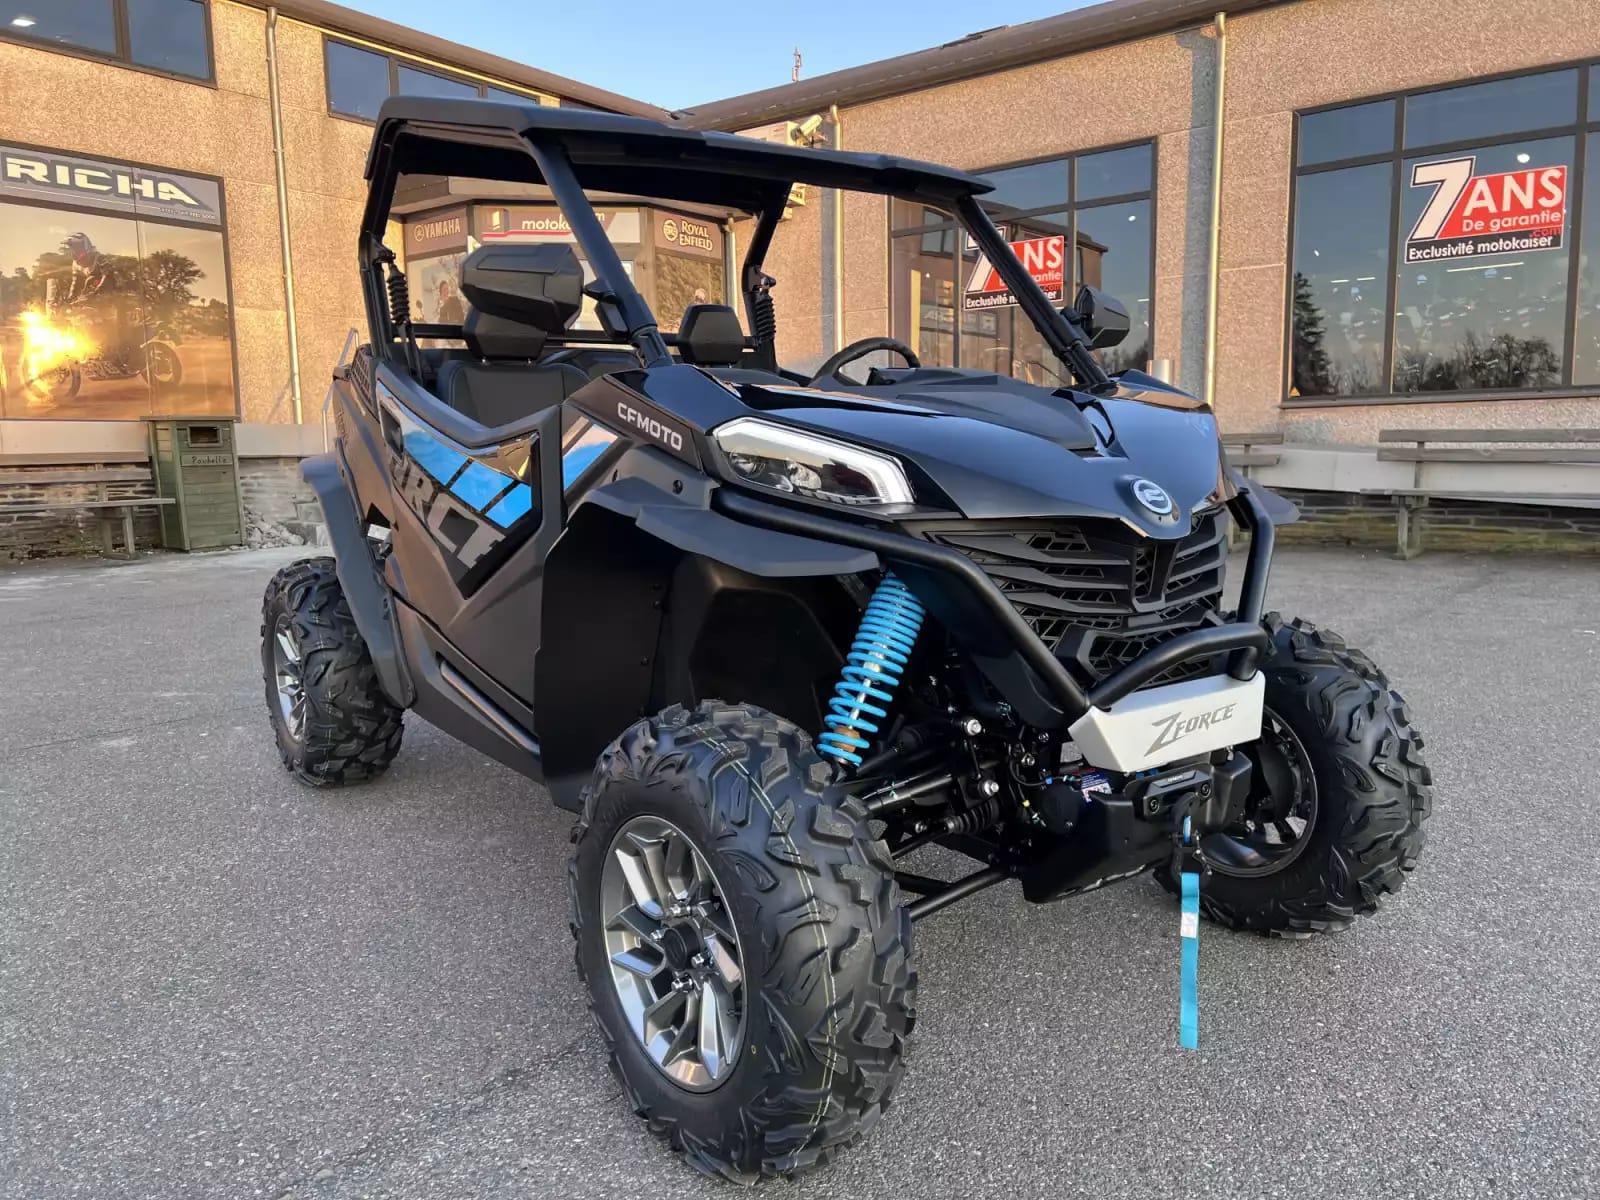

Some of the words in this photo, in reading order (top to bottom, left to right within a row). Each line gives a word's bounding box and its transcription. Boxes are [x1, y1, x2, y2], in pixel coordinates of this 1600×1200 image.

[6, 157, 200, 206] RICHA
[1411, 157, 1476, 241] 7
[1463, 168, 1563, 216] ANS
[424, 218, 460, 239] YAMAHA
[681, 220, 709, 238] ROYAL
[1462, 219, 1485, 232] De
[1490, 210, 1562, 232] garantie
[679, 233, 713, 251] ENFIELD
[1408, 241, 1474, 261] Exclusivité
[1477, 234, 1554, 254] motokaiser
[966, 293, 1008, 308] Exclusivité
[617, 402, 683, 451] CFMOTO
